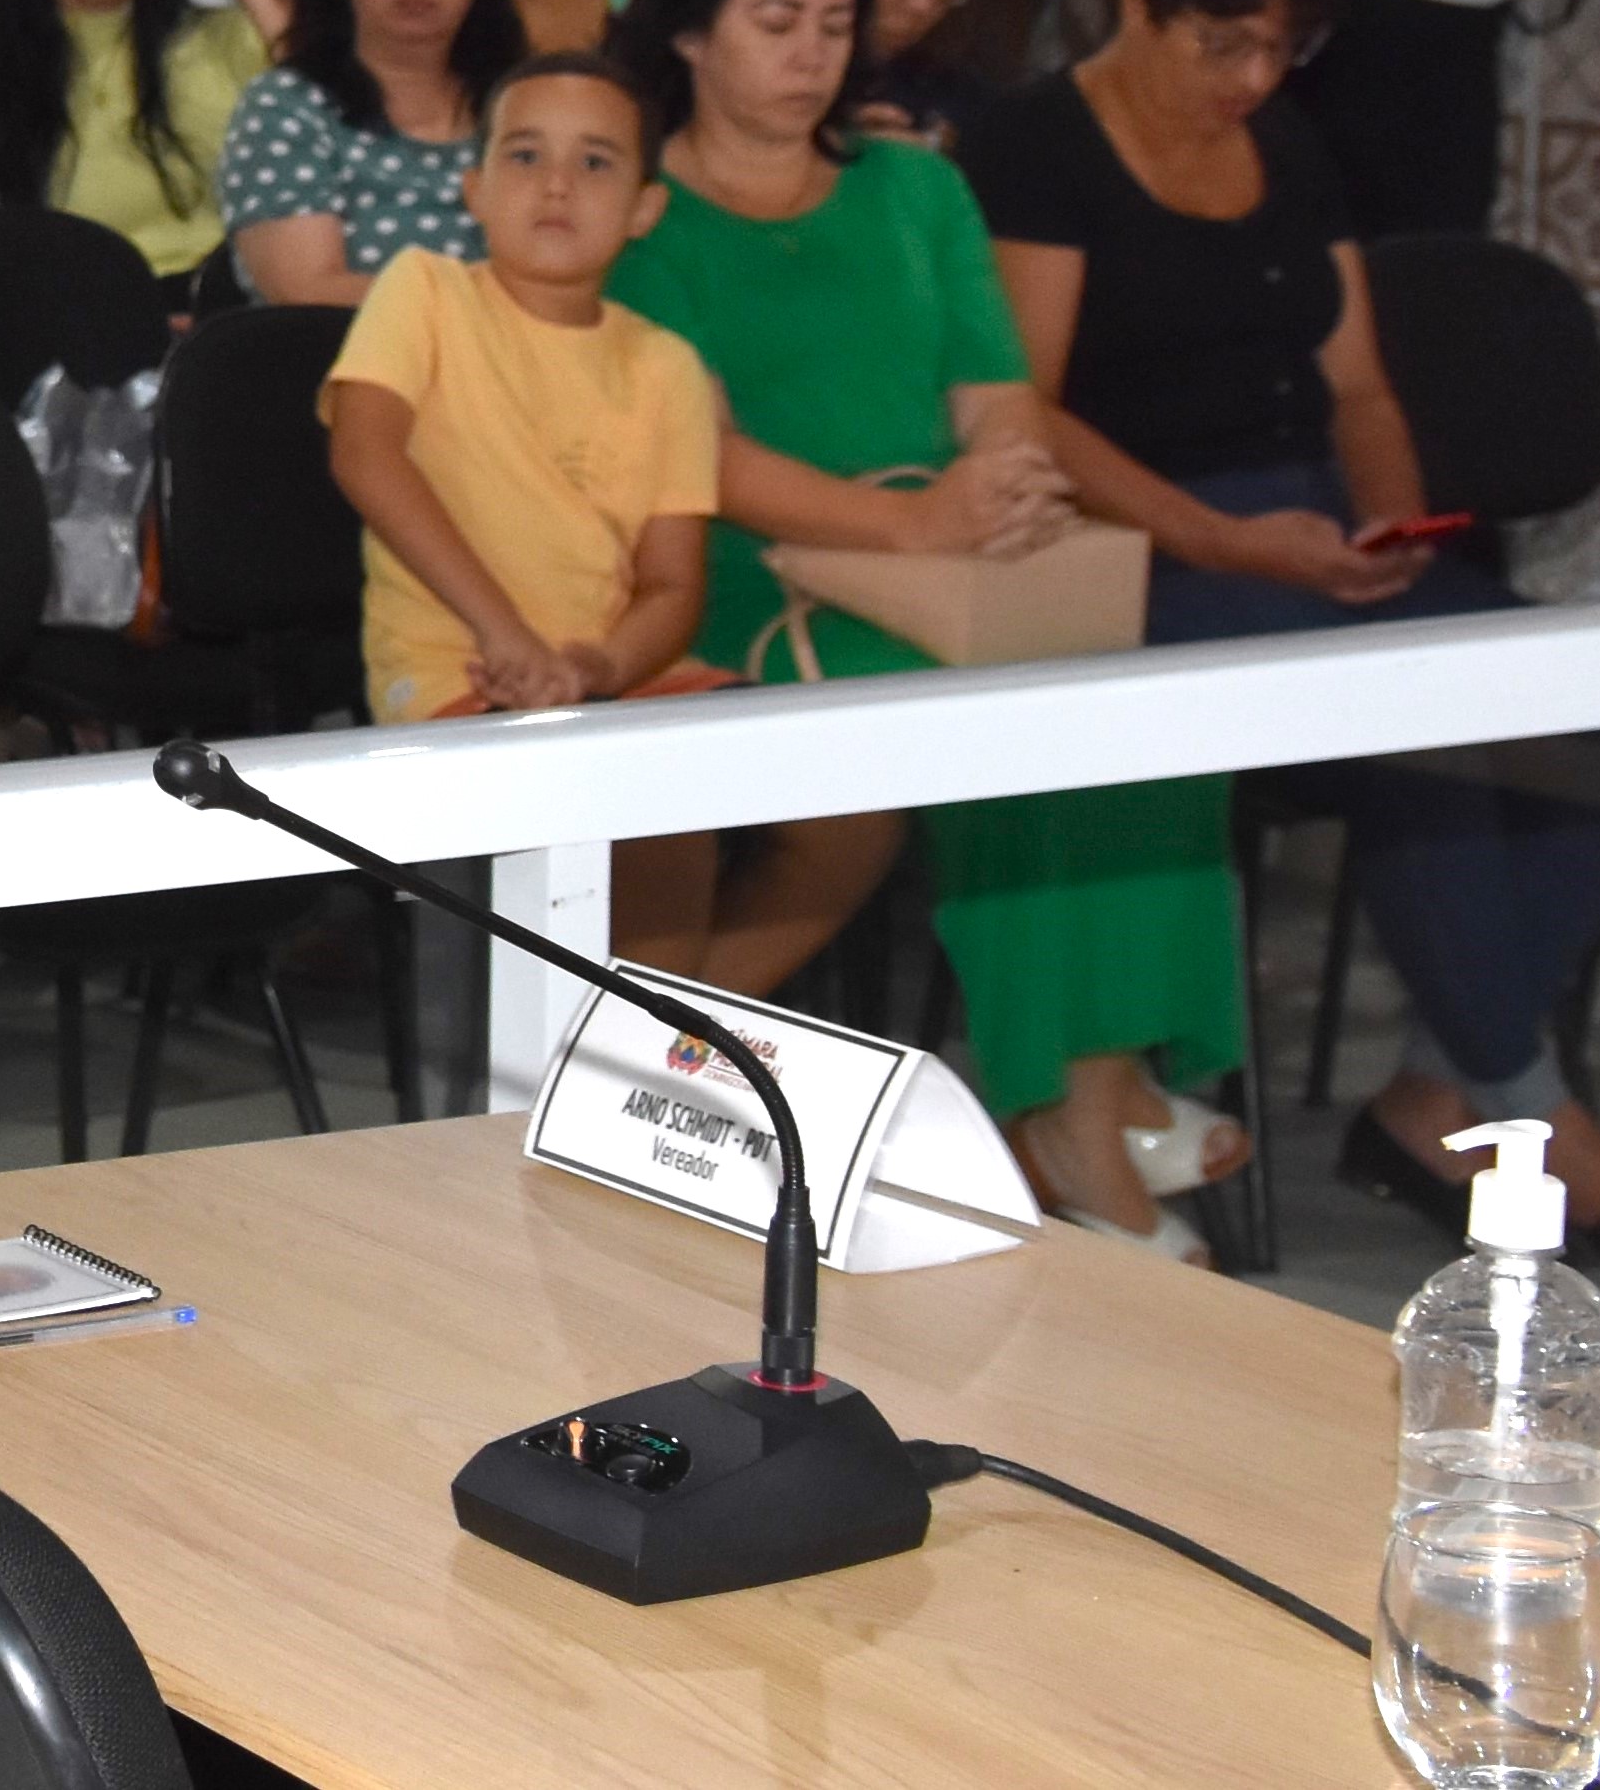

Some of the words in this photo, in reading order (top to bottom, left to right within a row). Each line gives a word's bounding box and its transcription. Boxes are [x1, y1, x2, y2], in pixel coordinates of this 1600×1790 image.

[621, 1088, 669, 1125] ARNO
[666, 1102, 735, 1147] SCHMIDT
[741, 1128, 779, 1162] PDT
[652, 1135, 719, 1181] Vereador
